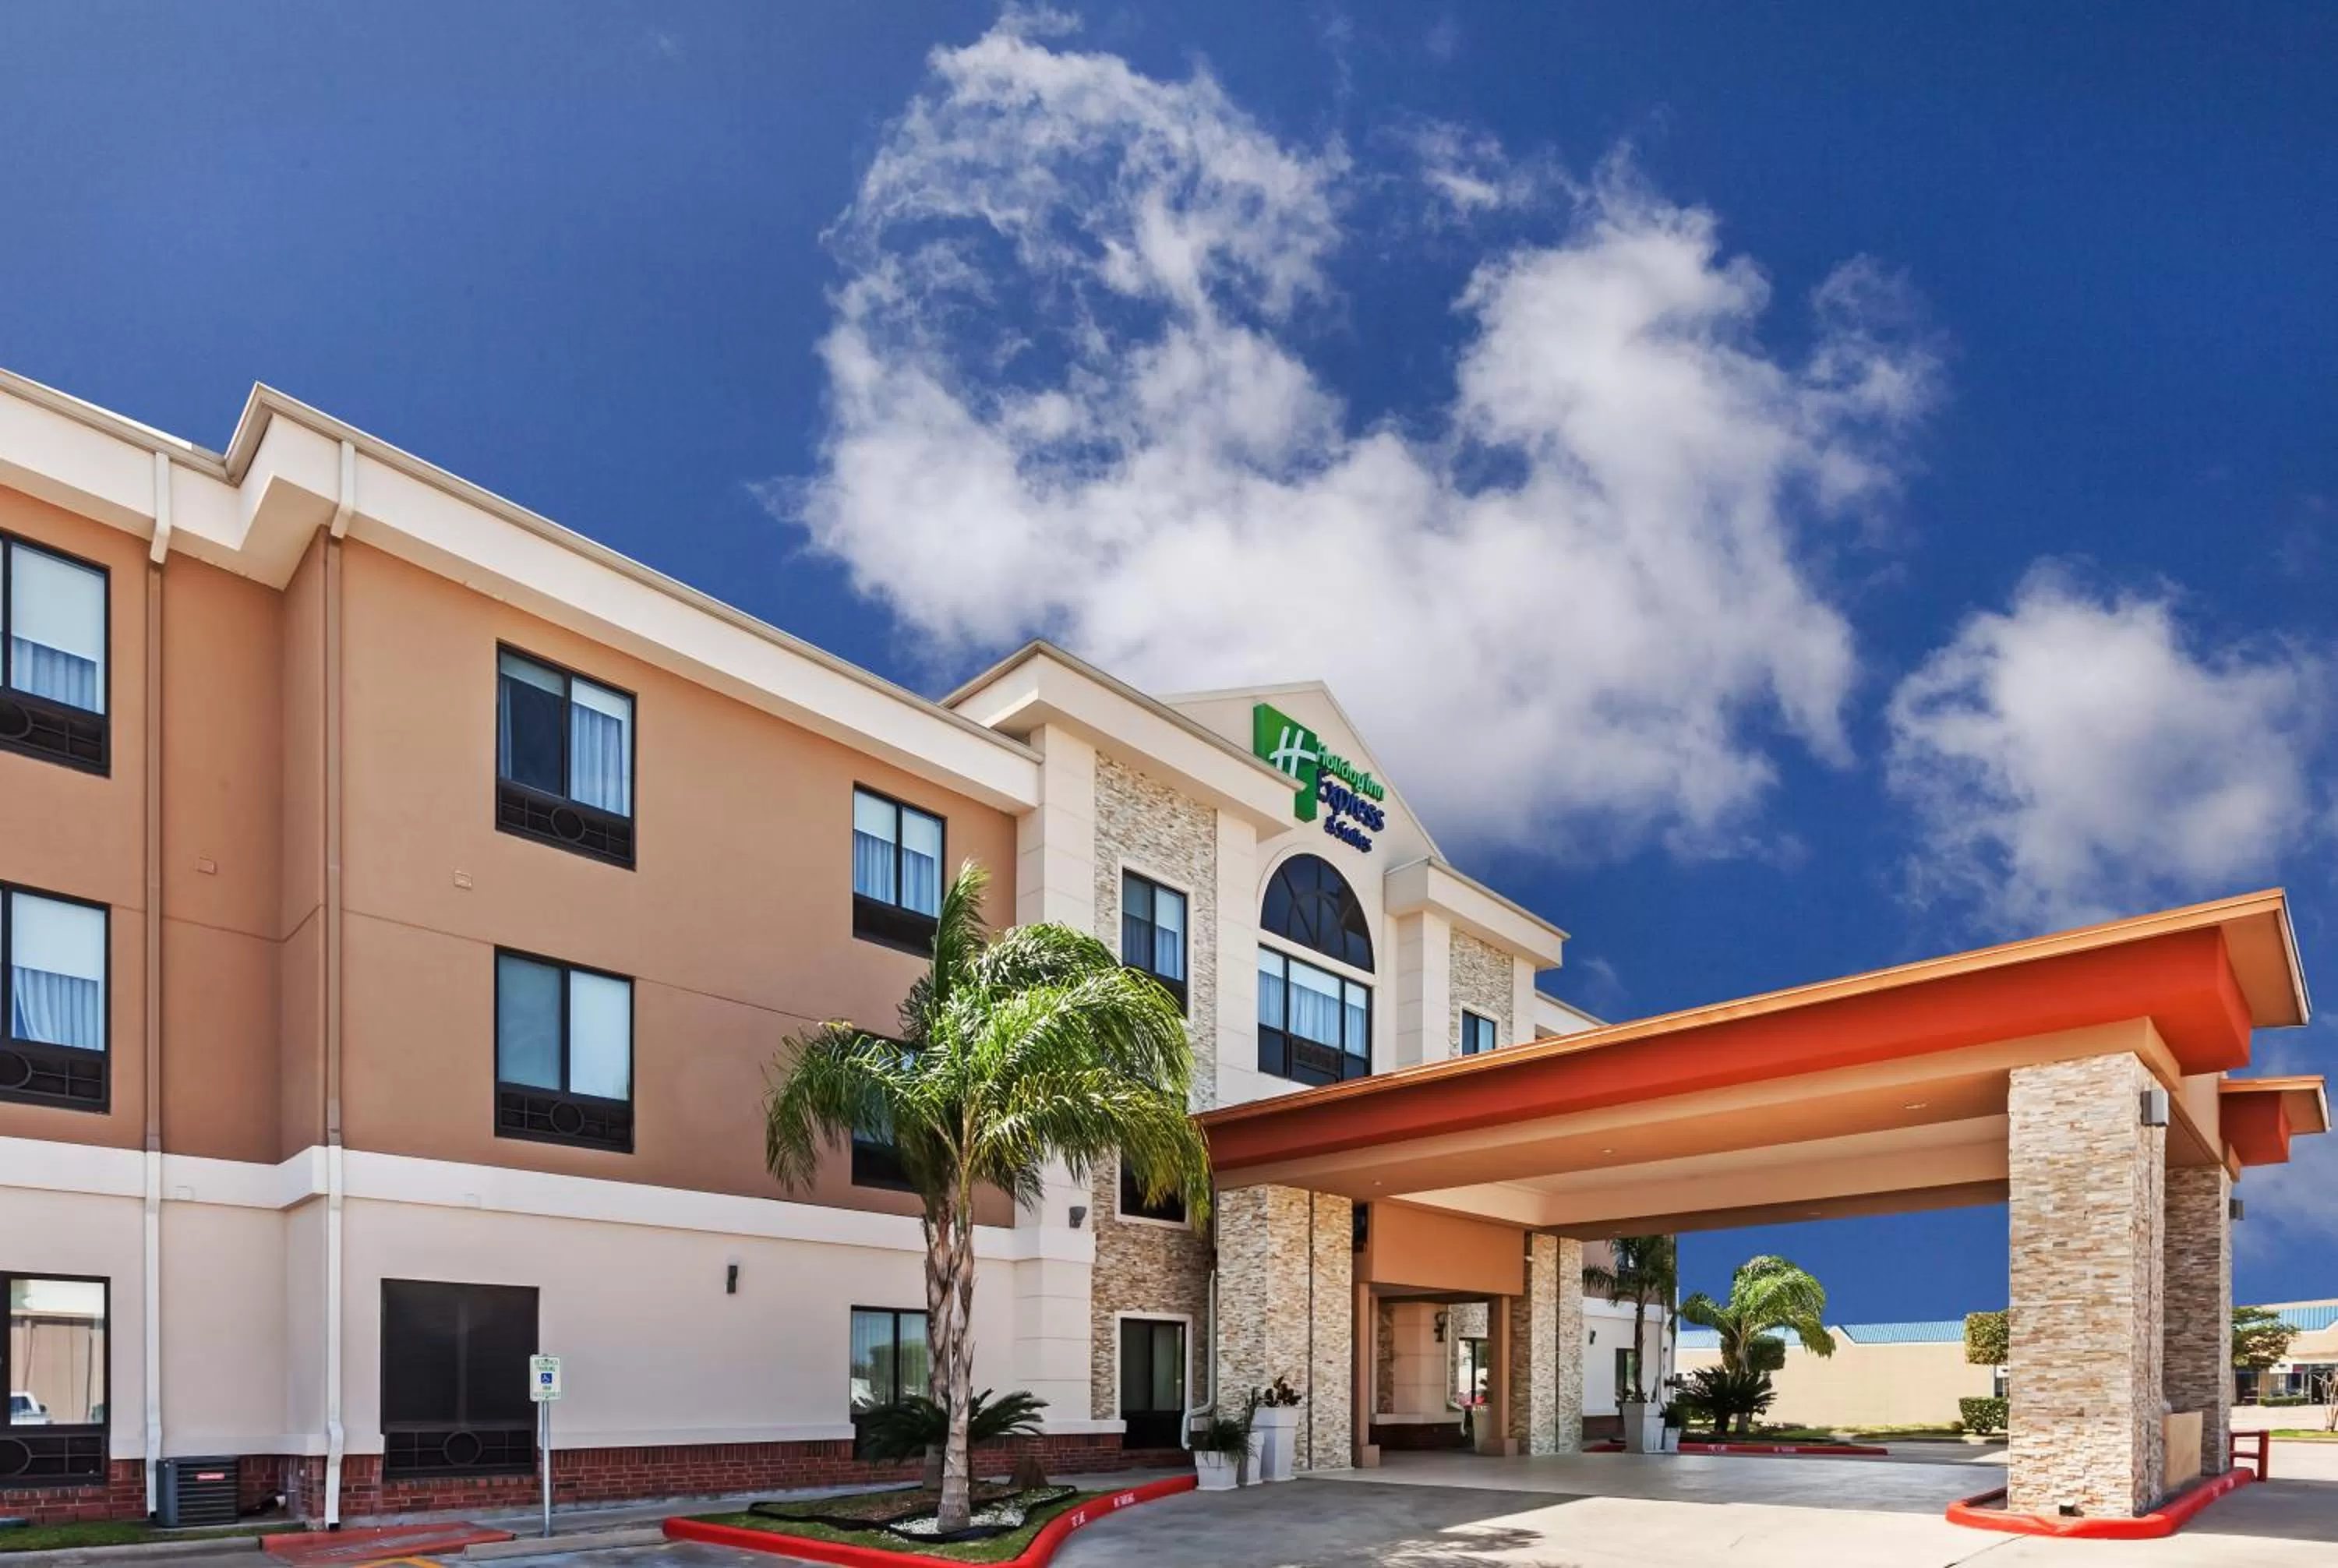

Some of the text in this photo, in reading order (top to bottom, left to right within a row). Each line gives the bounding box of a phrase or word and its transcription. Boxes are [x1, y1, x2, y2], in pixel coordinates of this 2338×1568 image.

[1316, 741, 1384, 801] Holiday Inn
[1316, 768, 1385, 832] Express
[1333, 821, 1372, 853] Suites
